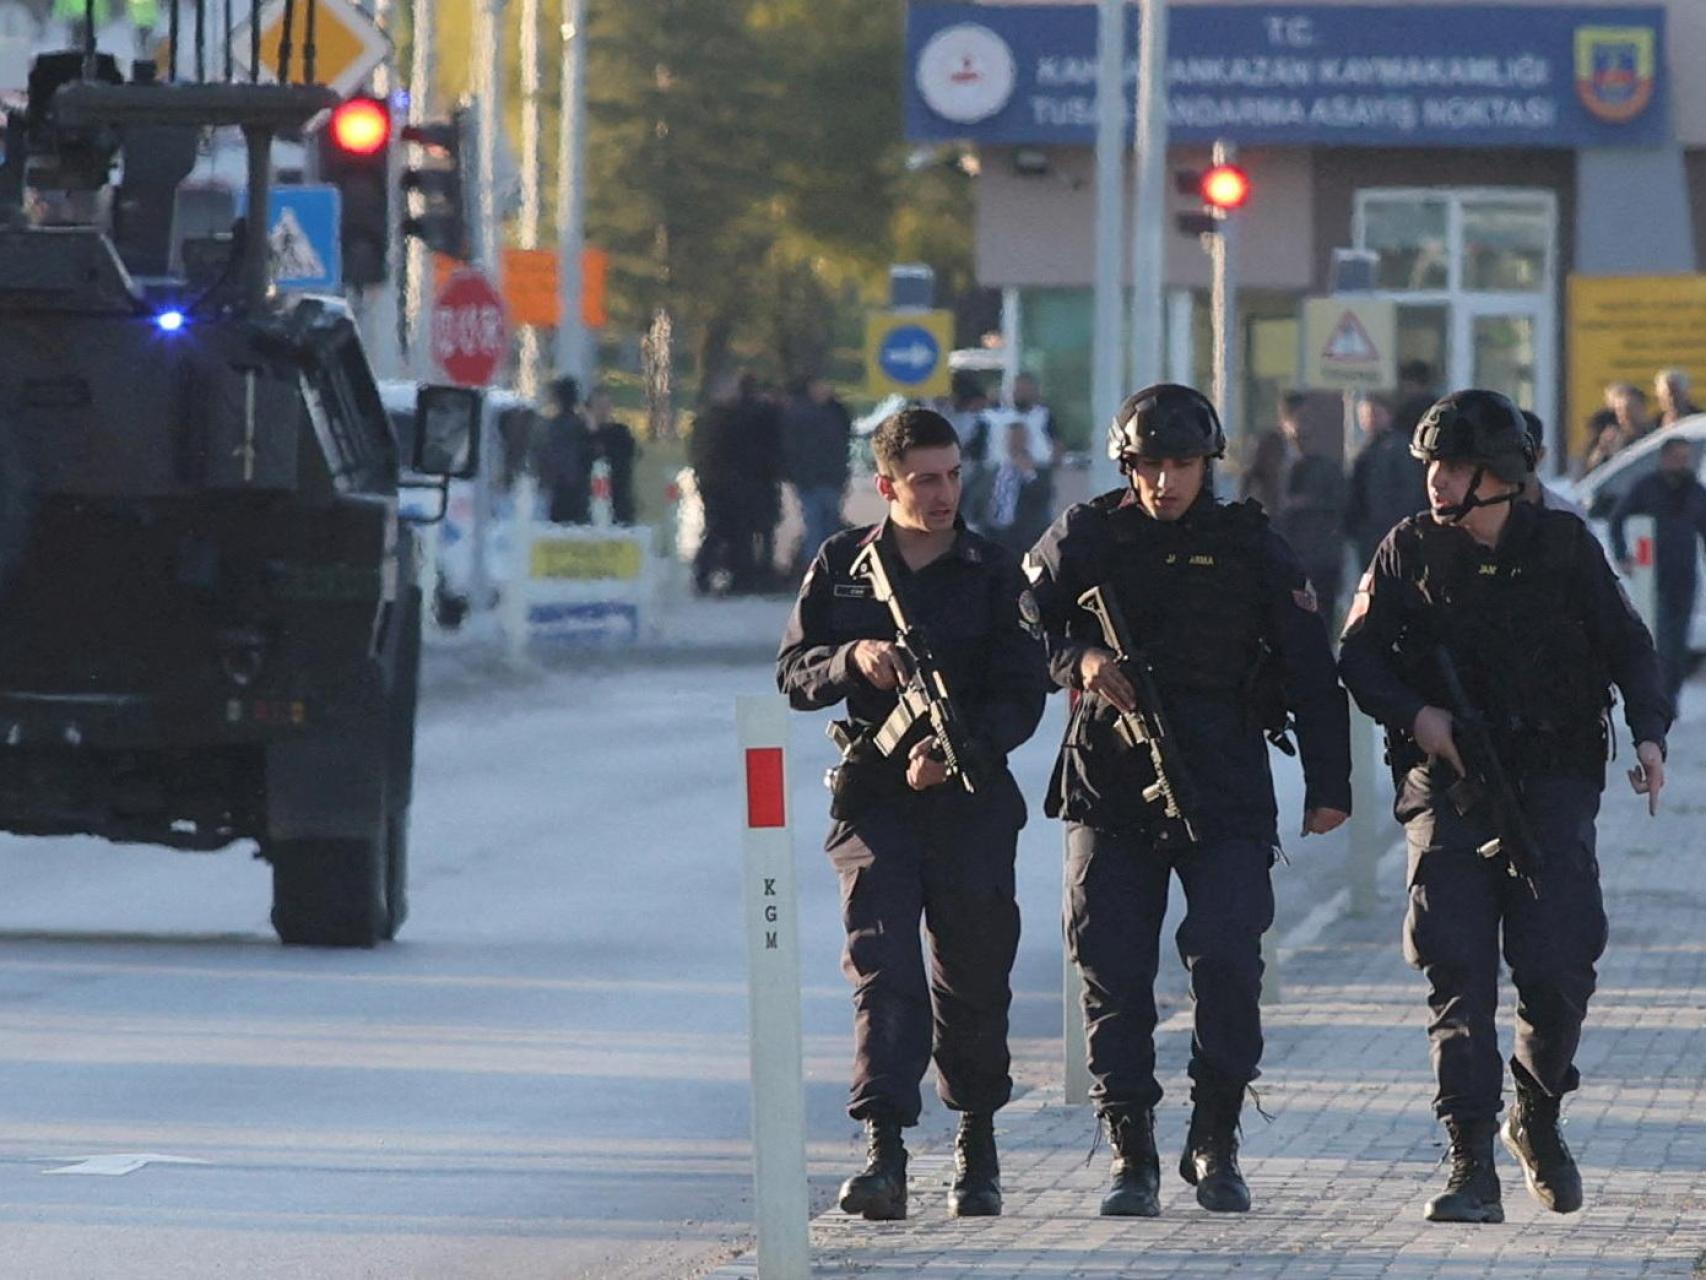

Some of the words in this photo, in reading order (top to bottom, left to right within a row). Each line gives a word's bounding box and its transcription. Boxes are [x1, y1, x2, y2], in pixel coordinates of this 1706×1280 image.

[1029, 95, 1123, 126] TUS
[1148, 95, 1304, 126] ANDARMA
[434, 302, 503, 350] DUR
[1165, 553, 1214, 565] JARMA
[763, 879, 777, 949] KGM
